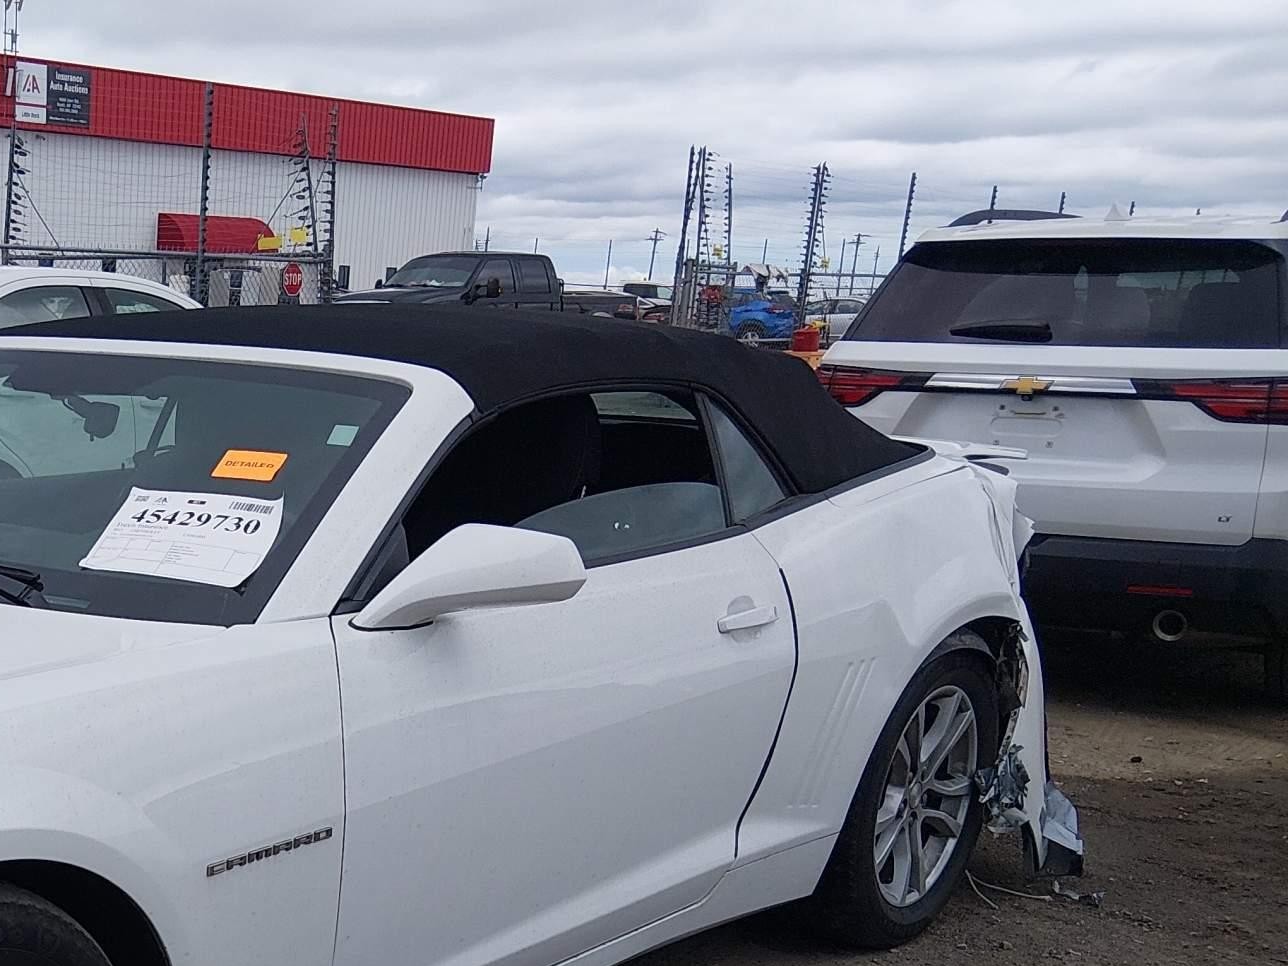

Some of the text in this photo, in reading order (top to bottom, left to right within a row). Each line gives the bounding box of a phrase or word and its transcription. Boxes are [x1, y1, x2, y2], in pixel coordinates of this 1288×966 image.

[55, 70, 84, 83] Insurance
[49, 80, 89, 94] Auto Auctions
[285, 273, 302, 286] STOP
[224, 460, 275, 469] DETAILED
[131, 508, 261, 535] 45429730
[206, 826, 333, 877] CAMARO
